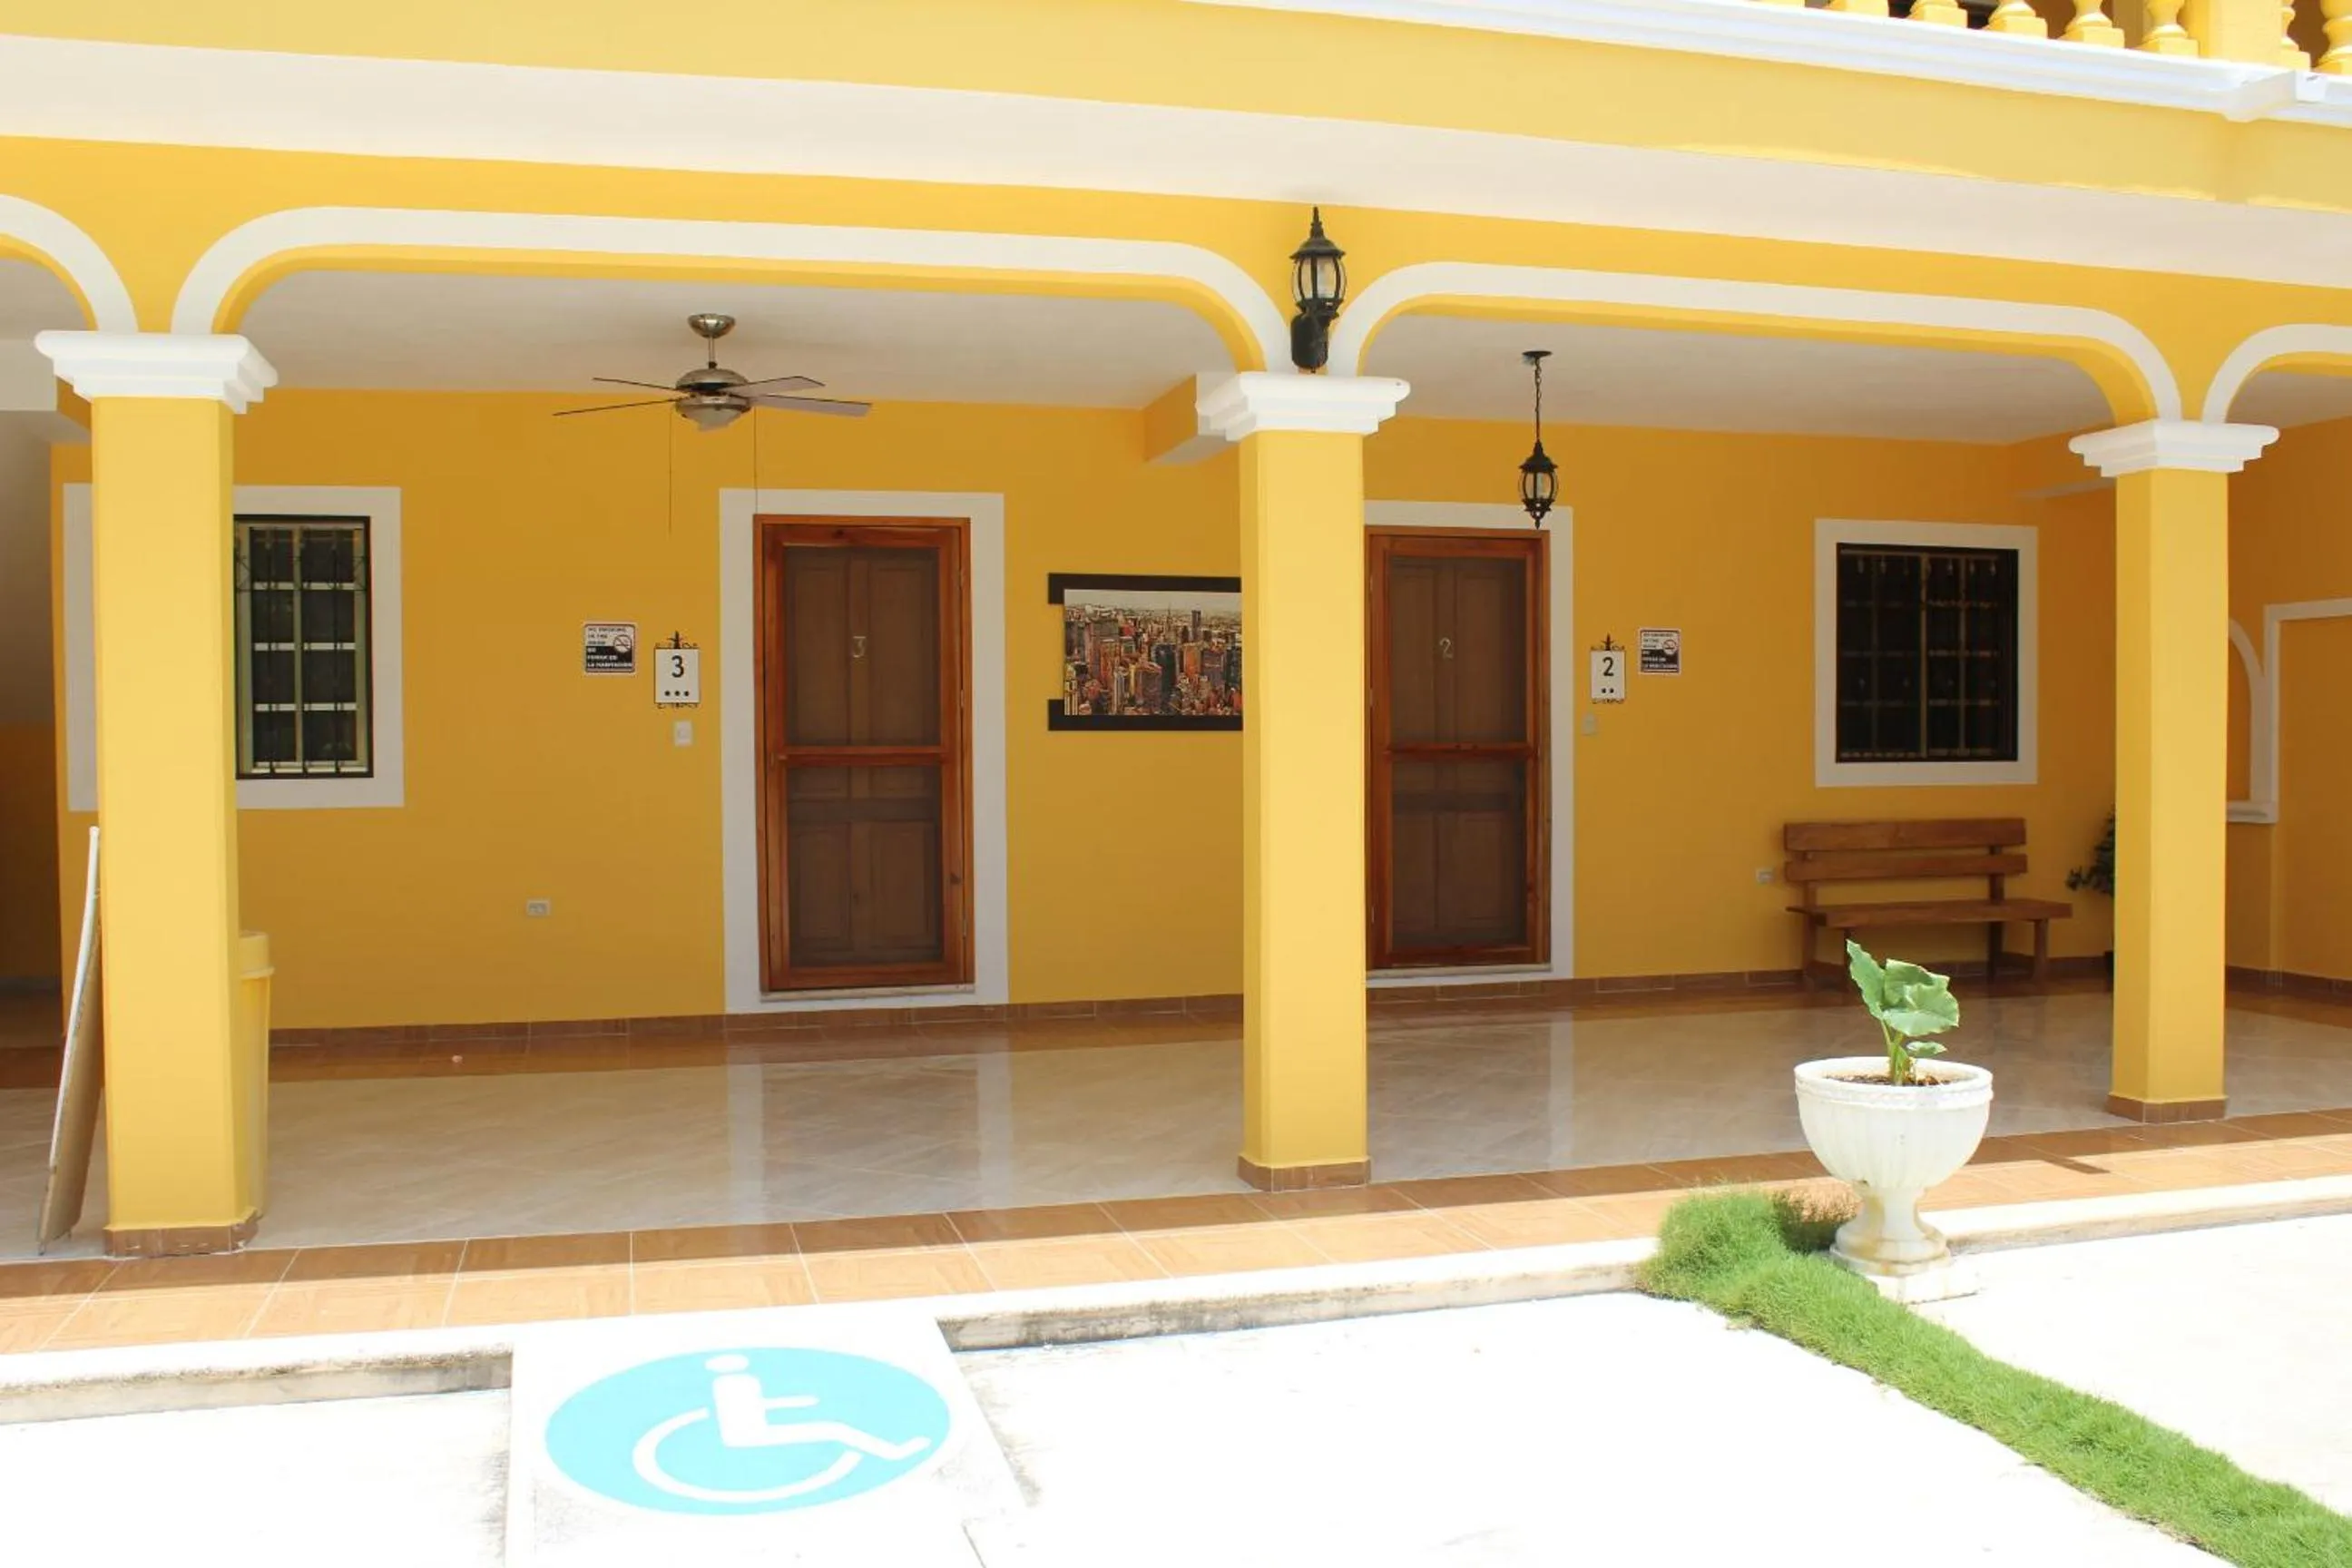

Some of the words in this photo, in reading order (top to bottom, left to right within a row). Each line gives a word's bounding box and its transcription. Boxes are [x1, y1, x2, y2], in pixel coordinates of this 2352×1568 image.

[852, 635, 866, 658] 3
[1439, 637, 1454, 660] 2
[671, 655, 684, 678] 3
[1602, 656, 1614, 677] 2
